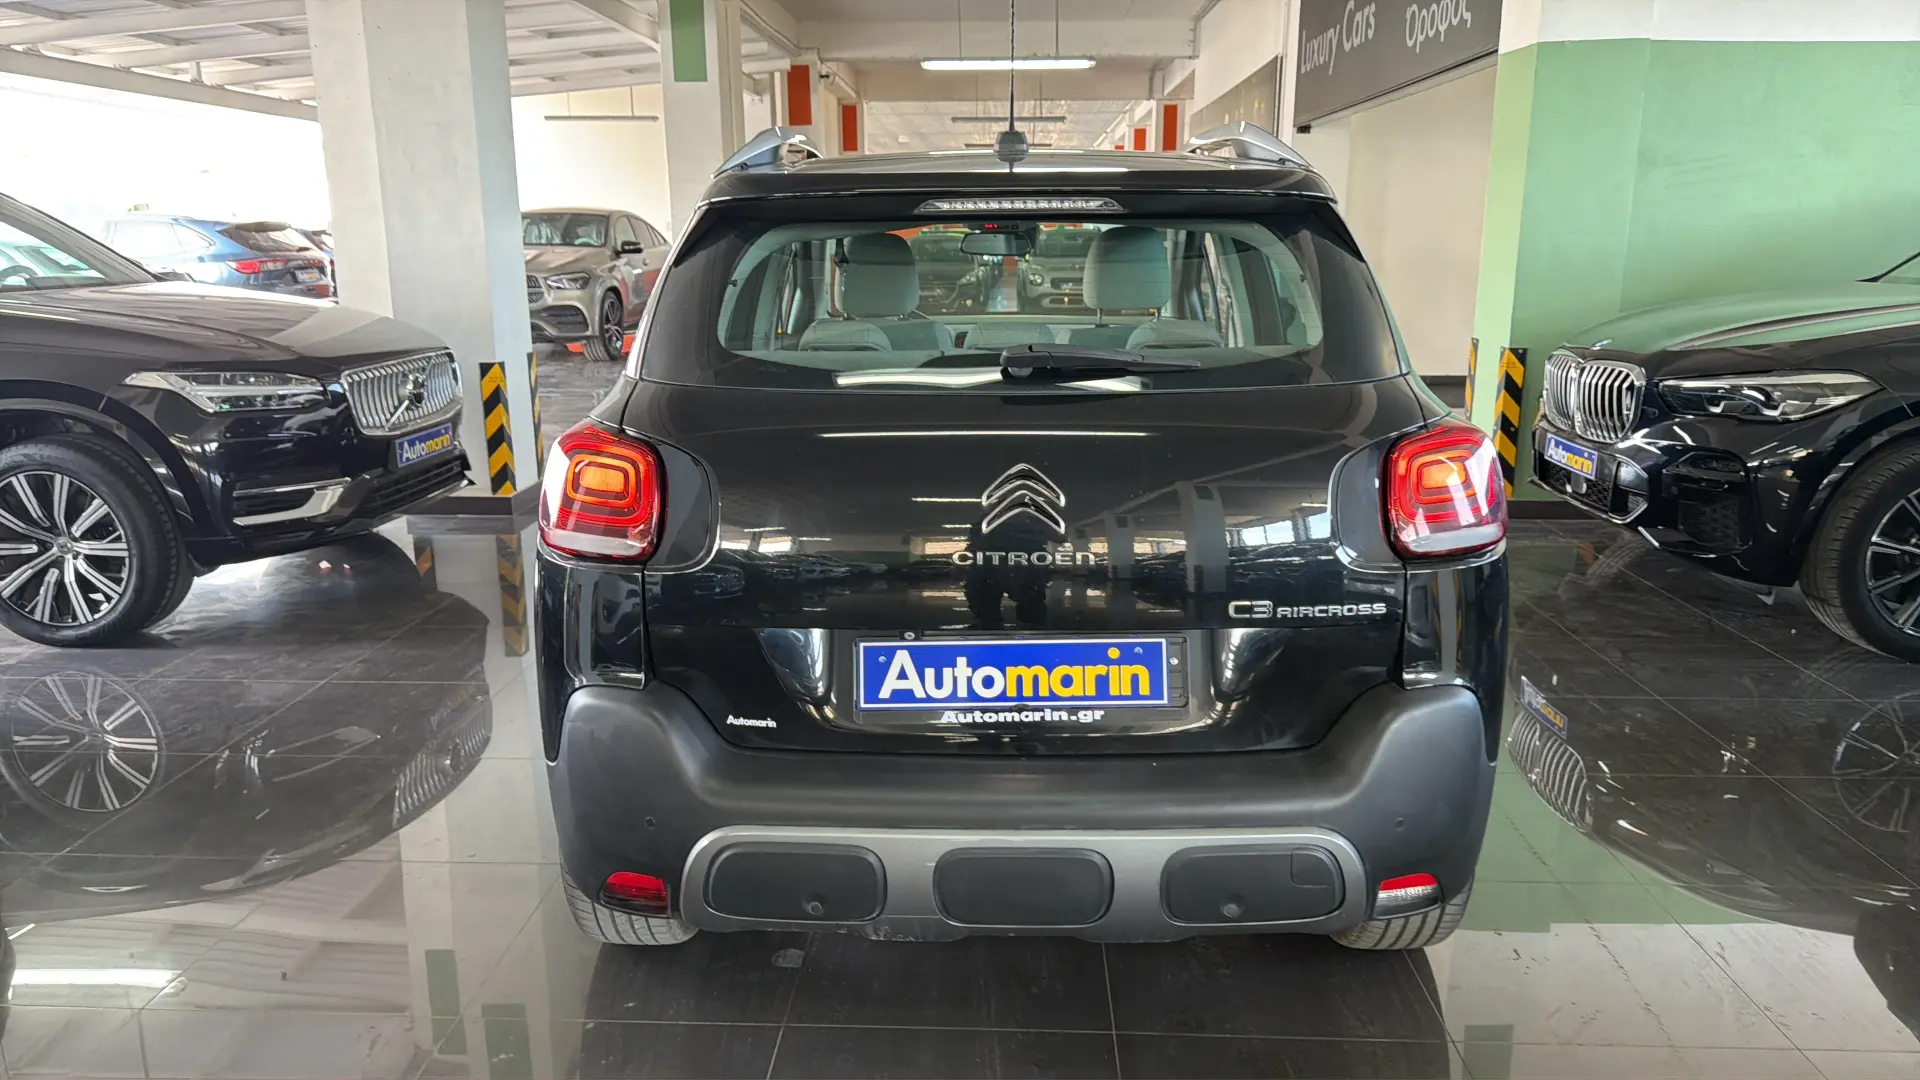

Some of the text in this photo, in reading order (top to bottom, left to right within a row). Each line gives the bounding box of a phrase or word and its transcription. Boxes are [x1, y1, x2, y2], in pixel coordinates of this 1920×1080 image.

[1300, 0, 1376, 75] Luxury Cars
[402, 428, 451, 462] Automarin
[1547, 438, 1593, 474] Automarin
[1228, 600, 1387, 618] C3 AIRCROSS
[878, 646, 1150, 699] Automarin
[726, 714, 777, 728] Automarin
[940, 708, 1104, 723] Automarin.gr
